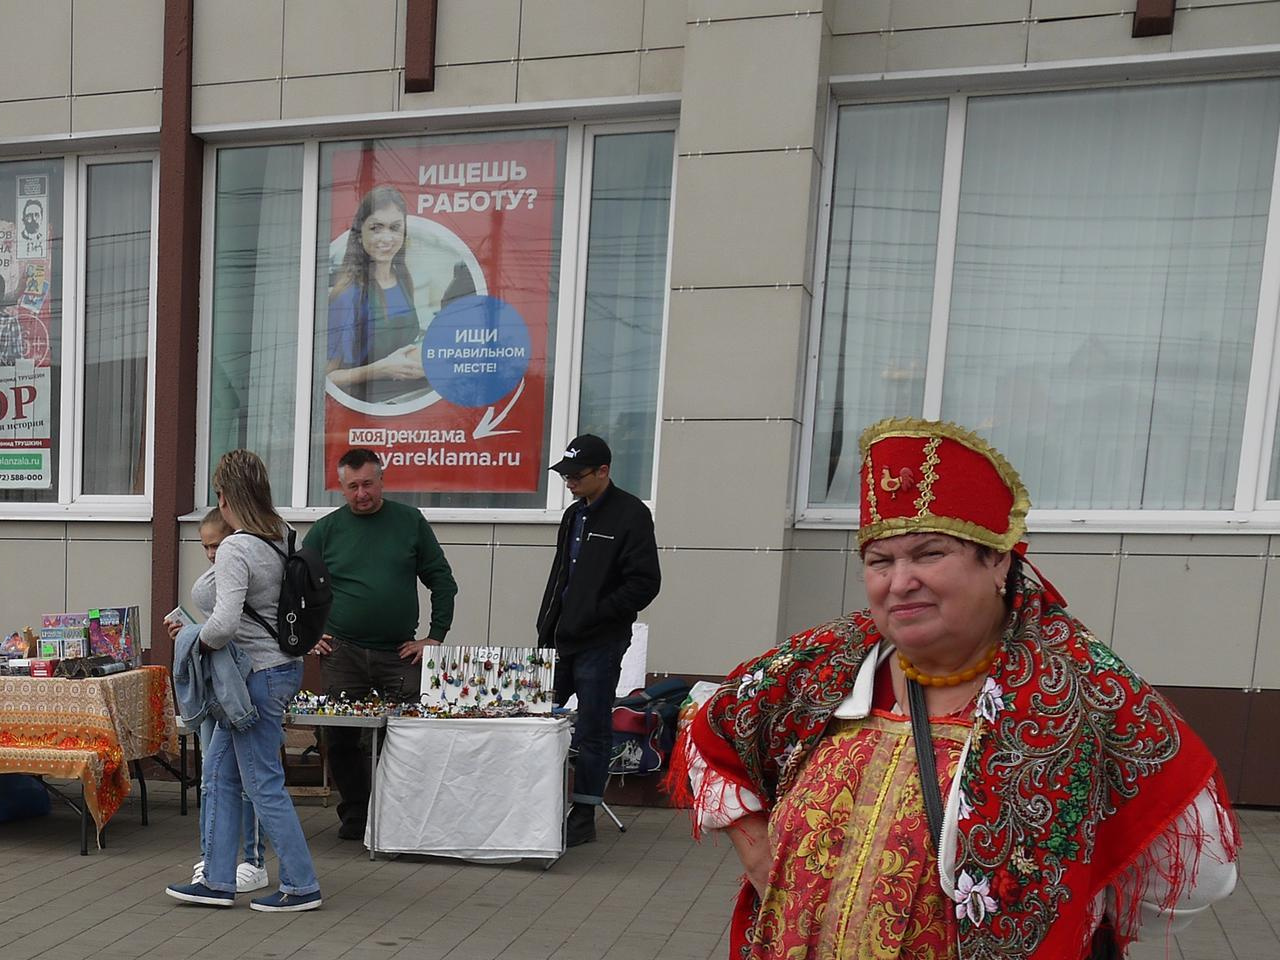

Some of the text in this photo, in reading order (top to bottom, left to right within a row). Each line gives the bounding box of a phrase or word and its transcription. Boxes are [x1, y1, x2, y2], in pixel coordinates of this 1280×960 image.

[418, 159, 528, 187] ИЩЕШЬ
[417, 188, 538, 214] РАБОТУ?
[455, 328, 498, 345] ИЩИ
[427, 347, 525, 359] В ПРАВИЛЬНОМ
[453, 363, 497, 374] МЕСТЕ!
[7, 419, 45, 432] история
[376, 448, 520, 470] yareklama.ru
[480, 651, 499, 660] 200
